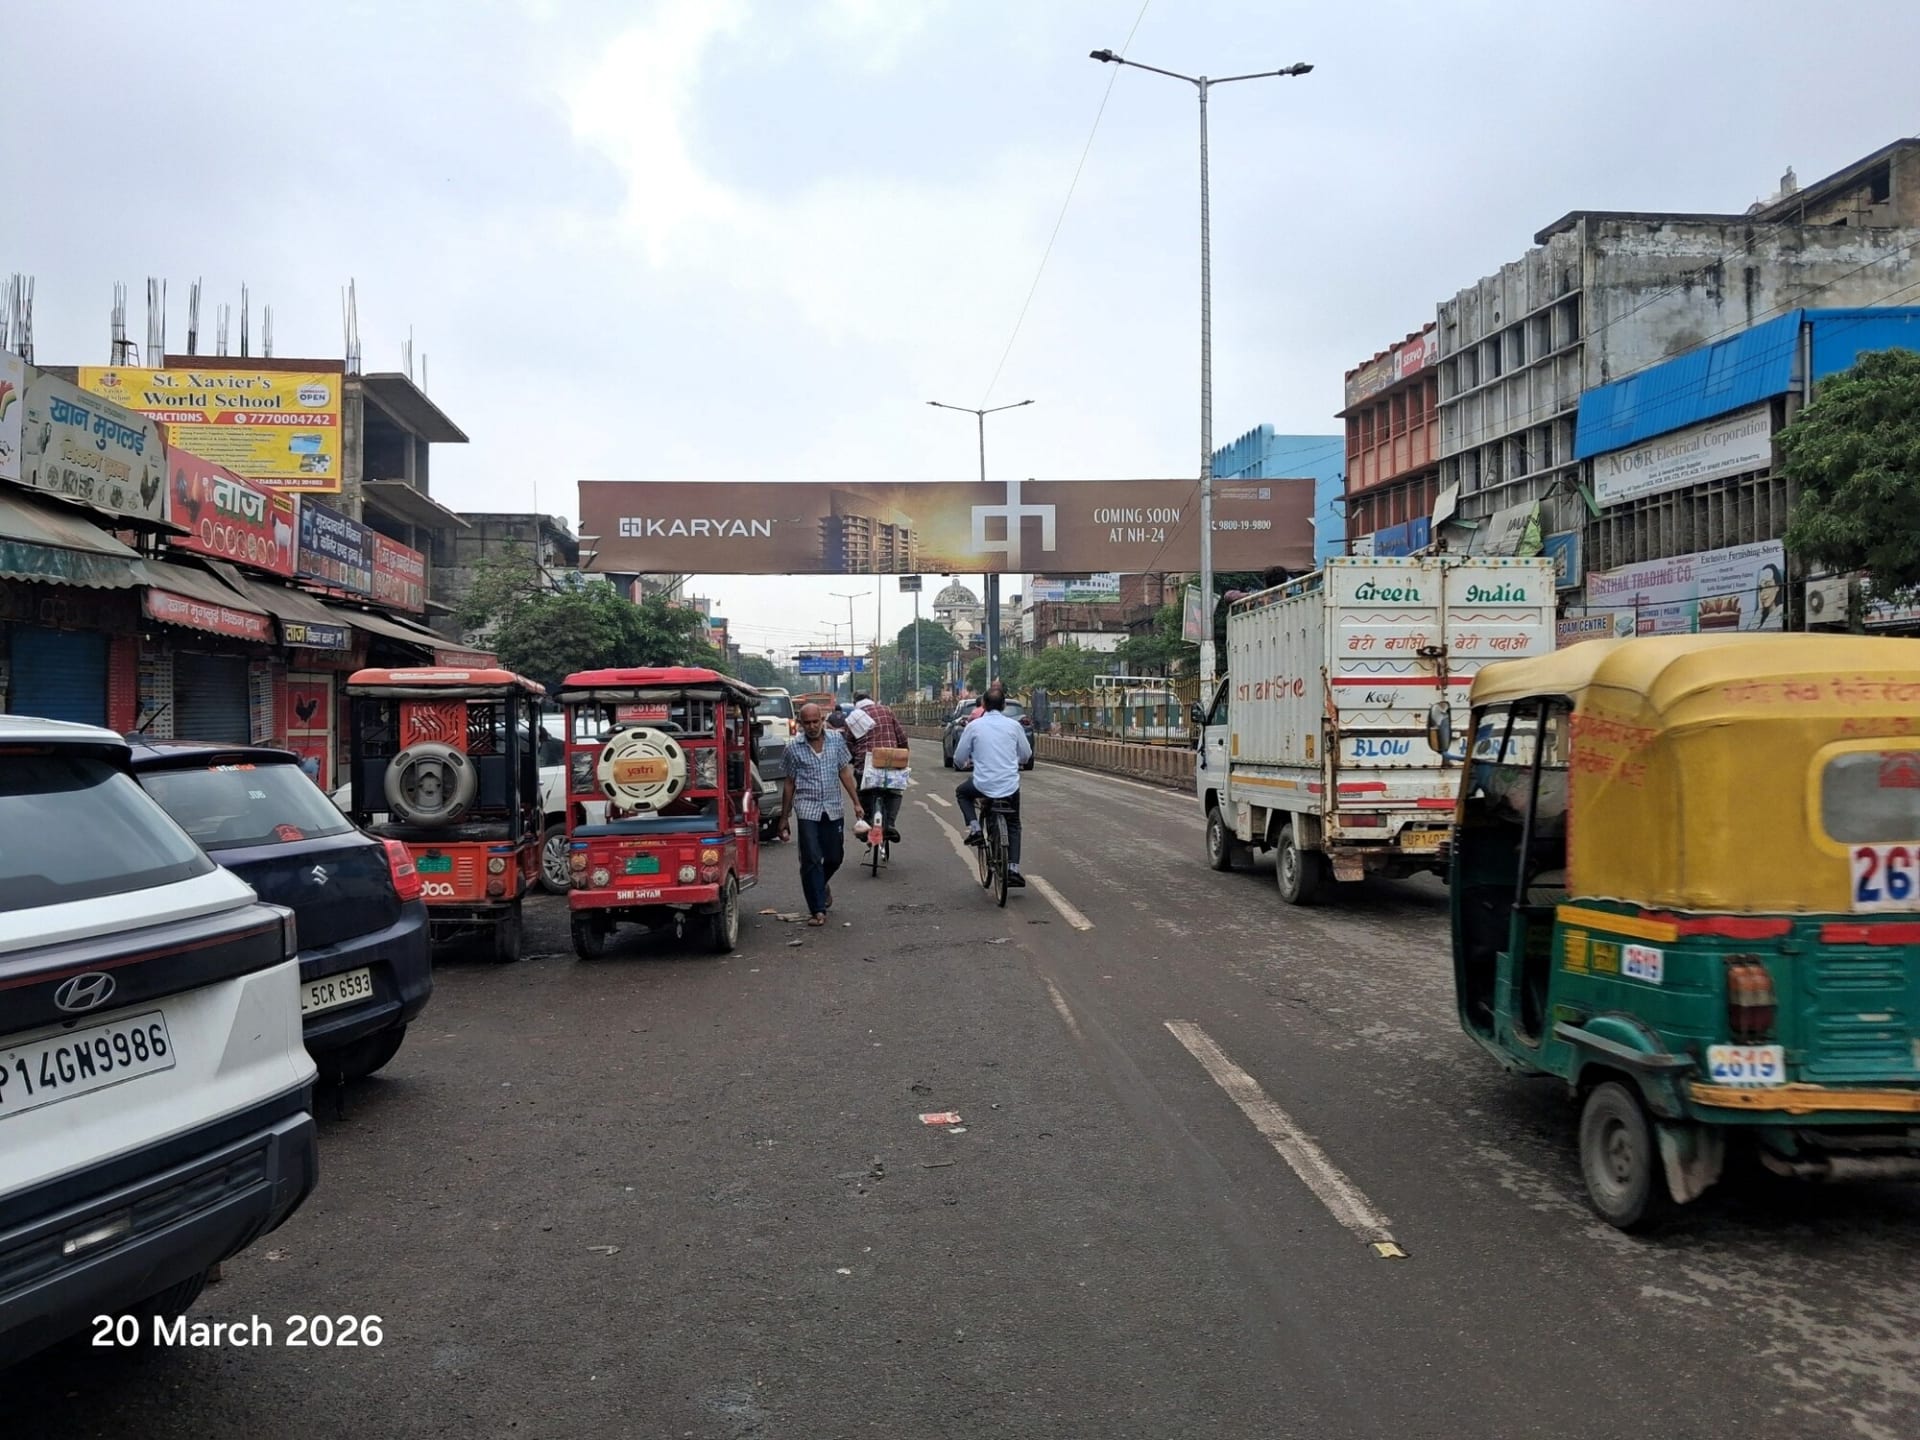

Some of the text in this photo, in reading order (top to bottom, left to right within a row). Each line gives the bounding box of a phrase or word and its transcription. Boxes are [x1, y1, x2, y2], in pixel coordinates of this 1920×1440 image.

[1403, 347, 1422, 367] SERVO
[152, 373, 272, 390] St. Xavier's
[143, 392, 207, 408] World
[214, 393, 281, 408] School
[299, 393, 326, 401] OPEN
[50, 396, 90, 432] खान
[93, 413, 148, 456] मुगलई
[250, 413, 331, 425] 7770004742
[1656, 436, 1700, 461] Electrical
[1703, 419, 1768, 450] Corporation
[212, 475, 267, 522] ताज
[646, 508, 1181, 537] KARYAN COMING SOON
[1109, 528, 1165, 543] AT NH-24
[1728, 547, 1760, 560] Furnishing
[1762, 545, 1780, 554] Store
[1631, 568, 1674, 591] TRADING
[1676, 565, 1694, 582] CO.
[1355, 582, 1527, 602] Green India
[286, 624, 305, 642] ताज
[1558, 616, 1607, 634] FOAM CENTRE
[1347, 633, 1377, 650] बेटी
[1455, 633, 1483, 650] बेटी
[1351, 738, 1410, 757] BLOW
[627, 764, 654, 776] yatri
[617, 890, 634, 900] SHRI
[311, 982, 338, 1006] 5CR
[339, 974, 371, 999] 6593
